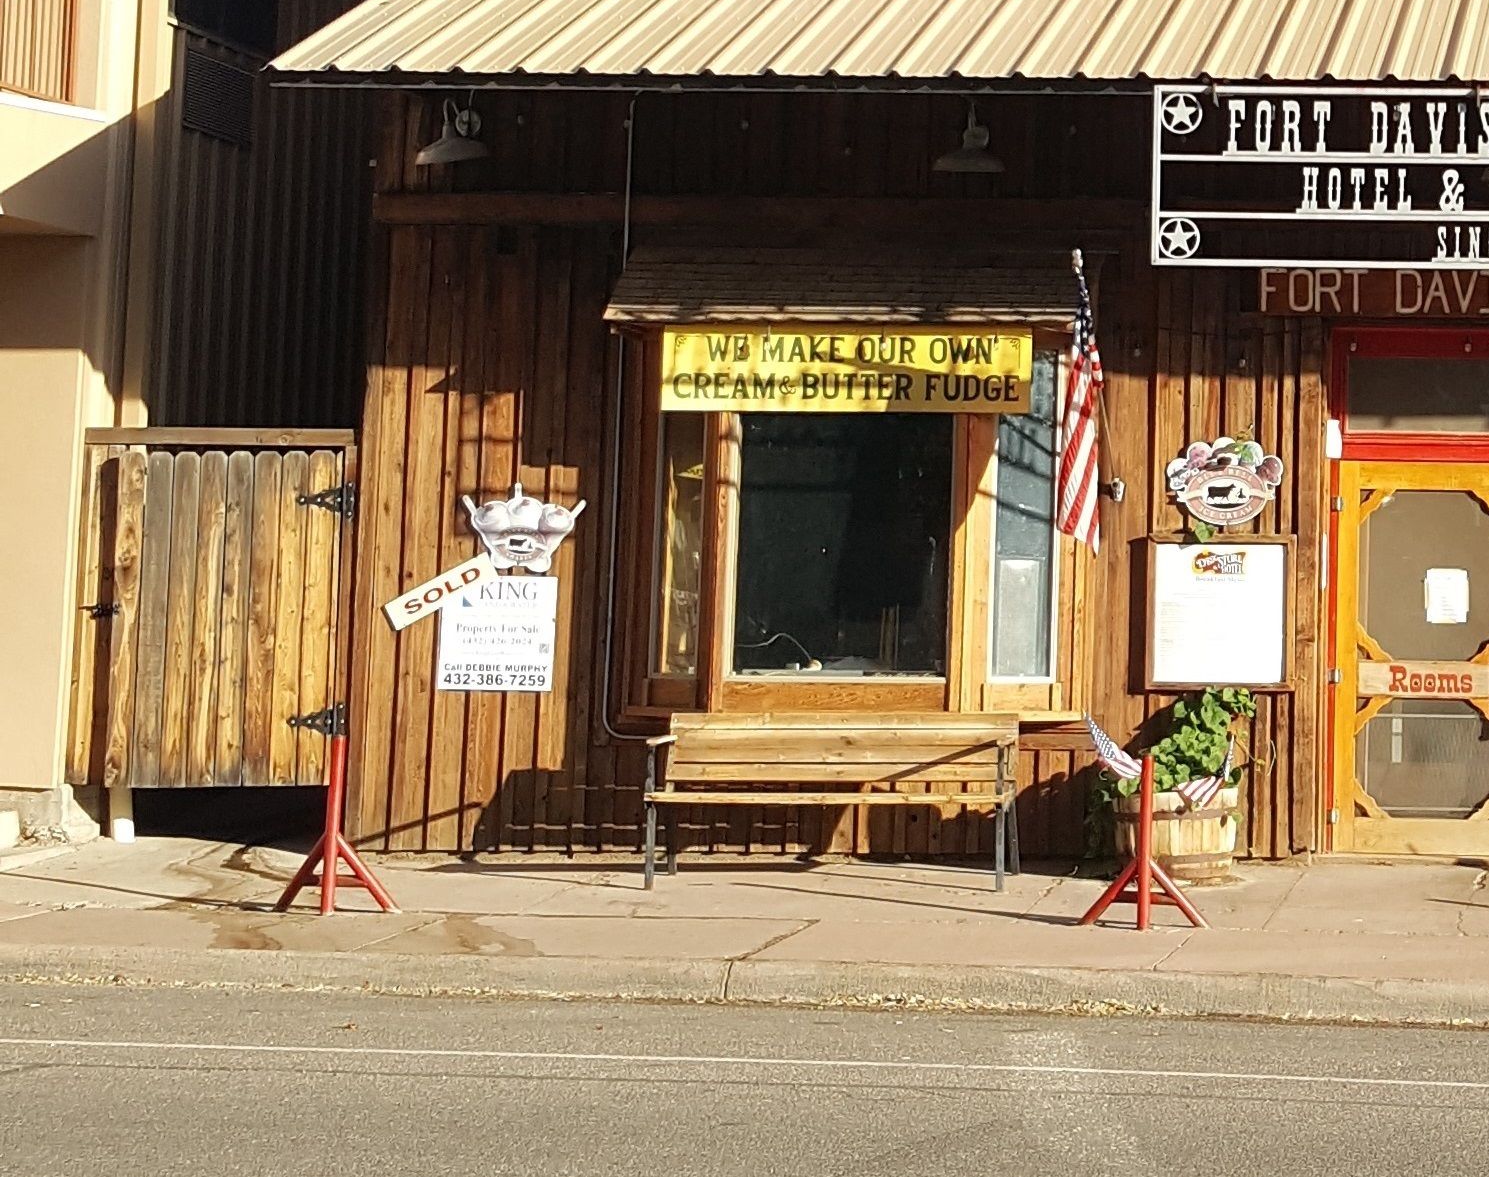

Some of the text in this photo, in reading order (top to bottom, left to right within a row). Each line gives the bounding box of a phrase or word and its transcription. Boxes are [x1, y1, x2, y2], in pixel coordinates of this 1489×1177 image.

[1226, 99, 1331, 156] FORT
[1301, 166, 1412, 212] HOTEL
[1440, 169, 1465, 213] &
[1259, 269, 1368, 313] FORT
[706, 336, 994, 365] WE MAKE OUR OWN
[672, 372, 1021, 402] CREAM & BUTTER FUDGE
[404, 567, 481, 615] SOLD
[479, 581, 538, 601] KING
[443, 673, 546, 687] 432-386-7259
[444, 662, 548, 673] Call DEBBIE MURPHY
[1389, 665, 1474, 693] Rooms
